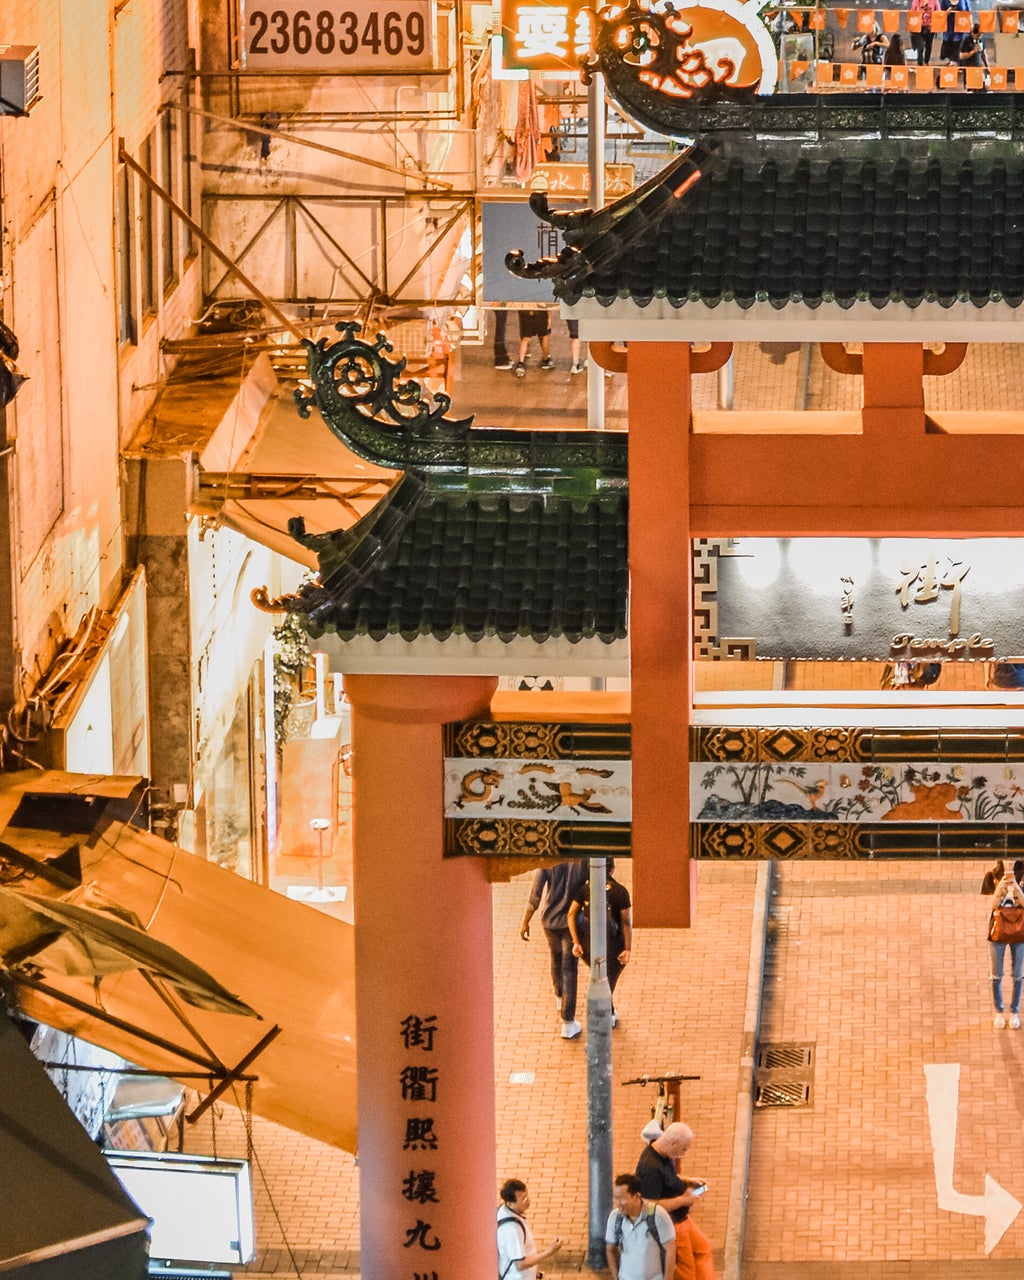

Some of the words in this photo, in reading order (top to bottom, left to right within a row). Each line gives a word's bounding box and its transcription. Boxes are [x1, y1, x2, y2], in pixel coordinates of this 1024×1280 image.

[249, 10, 425, 56] 23683469
[890, 632, 995, 654] Temple
[400, 1015, 441, 1280] 街衢熙攘九
